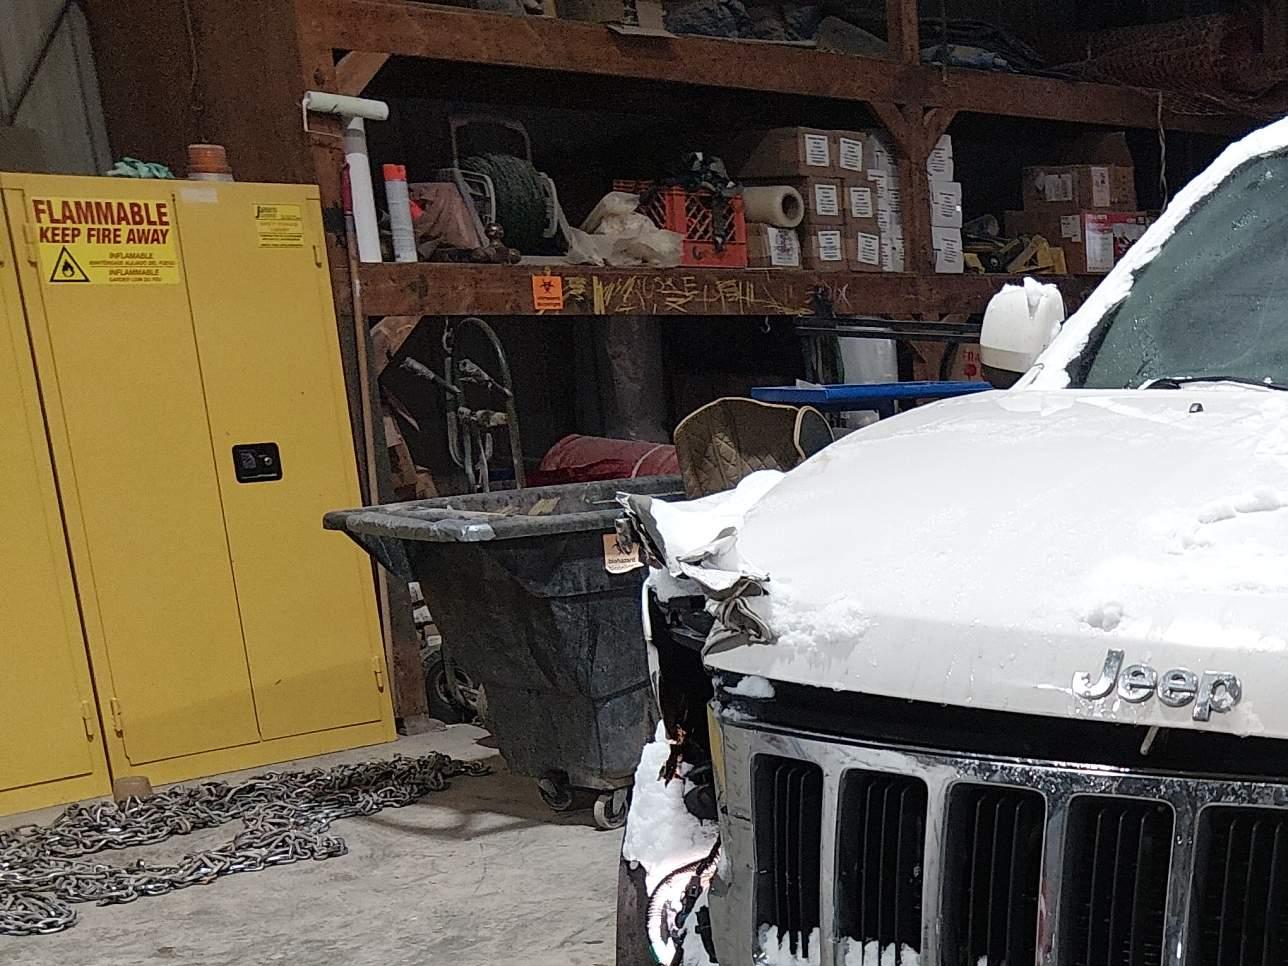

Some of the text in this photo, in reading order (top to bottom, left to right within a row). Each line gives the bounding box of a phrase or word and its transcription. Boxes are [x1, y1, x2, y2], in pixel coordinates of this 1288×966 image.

[32, 199, 170, 226] FLAMMABLE
[39, 226, 169, 245] KEEP FIRE AWAY
[1072, 648, 1243, 722] Jeep
